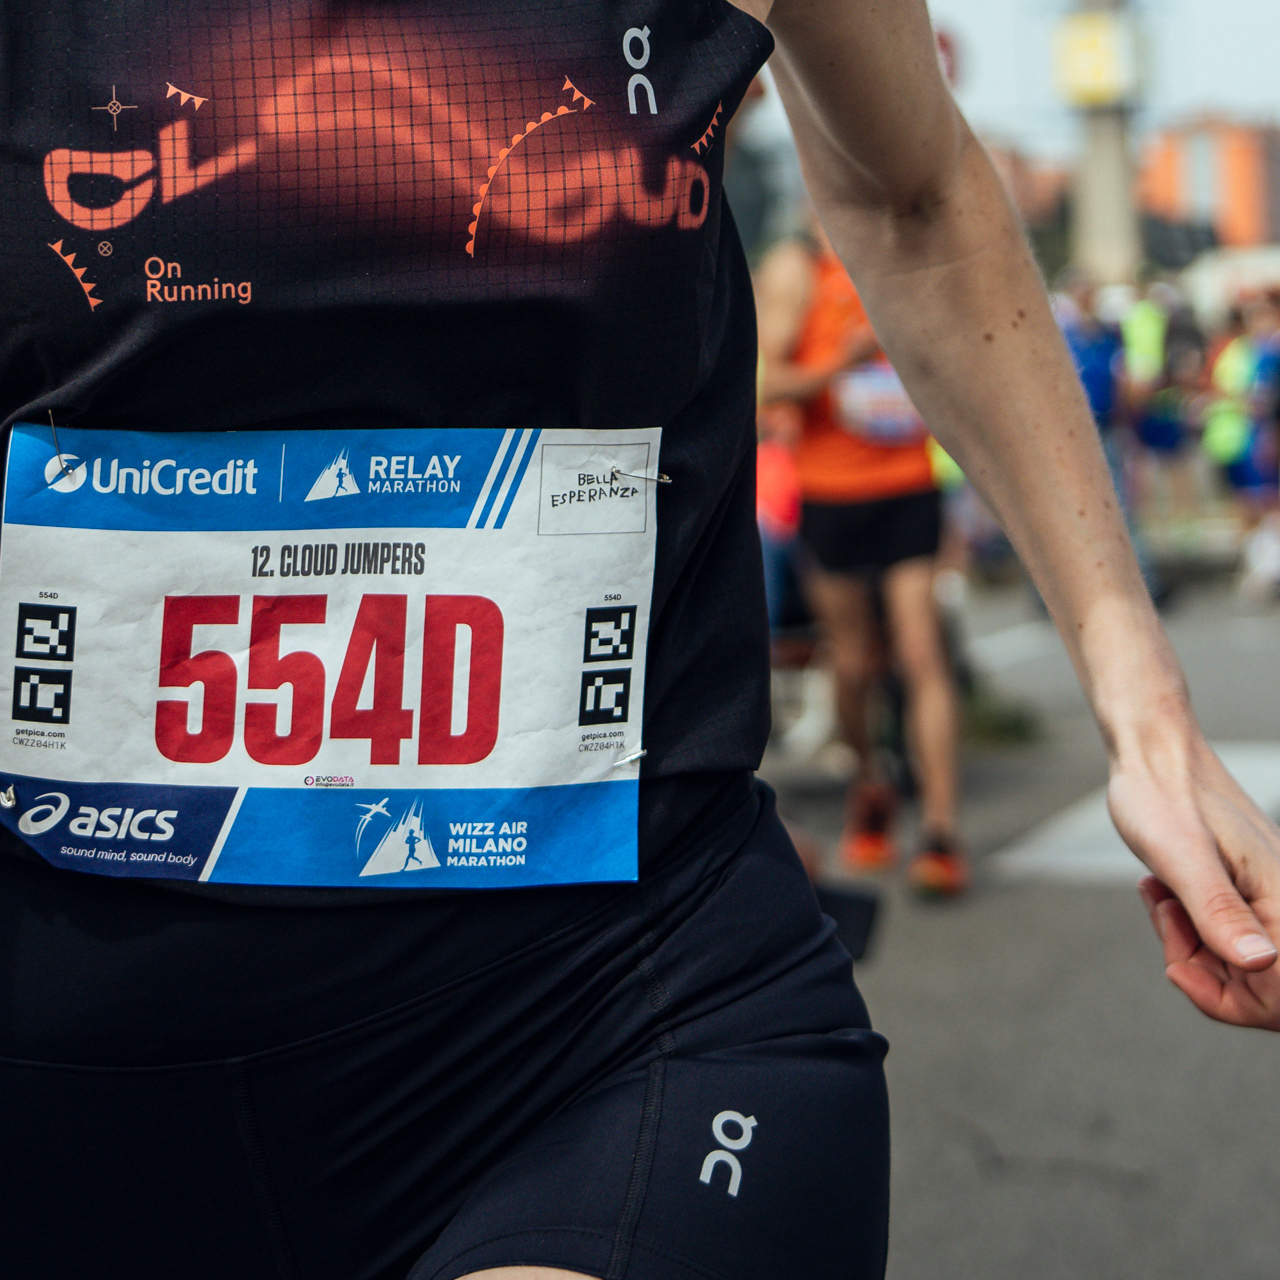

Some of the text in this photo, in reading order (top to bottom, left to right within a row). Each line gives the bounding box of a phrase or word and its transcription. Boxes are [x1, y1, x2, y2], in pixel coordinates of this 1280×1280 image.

[144, 257, 182, 279] On
[145, 278, 252, 304] Running
[91, 457, 258, 496] UniCredit
[369, 454, 462, 480] RELAY
[367, 478, 461, 494] MARATHON
[578, 472, 618, 486] BELLA
[551, 487, 638, 507] ESPERANZA
[251, 541, 426, 578] 12. CLOUD JUMPERS
[154, 593, 505, 766] 554D
[15, 728, 65, 738] getpica.com
[581, 731, 624, 741] getpica.com
[12, 737, 66, 750] CWZZ04H1K
[449, 820, 527, 837] WIZZ AIR
[448, 835, 527, 853] MILANO
[61, 845, 197, 866] sound mind, sound body
[446, 851, 526, 867] MARATHON
